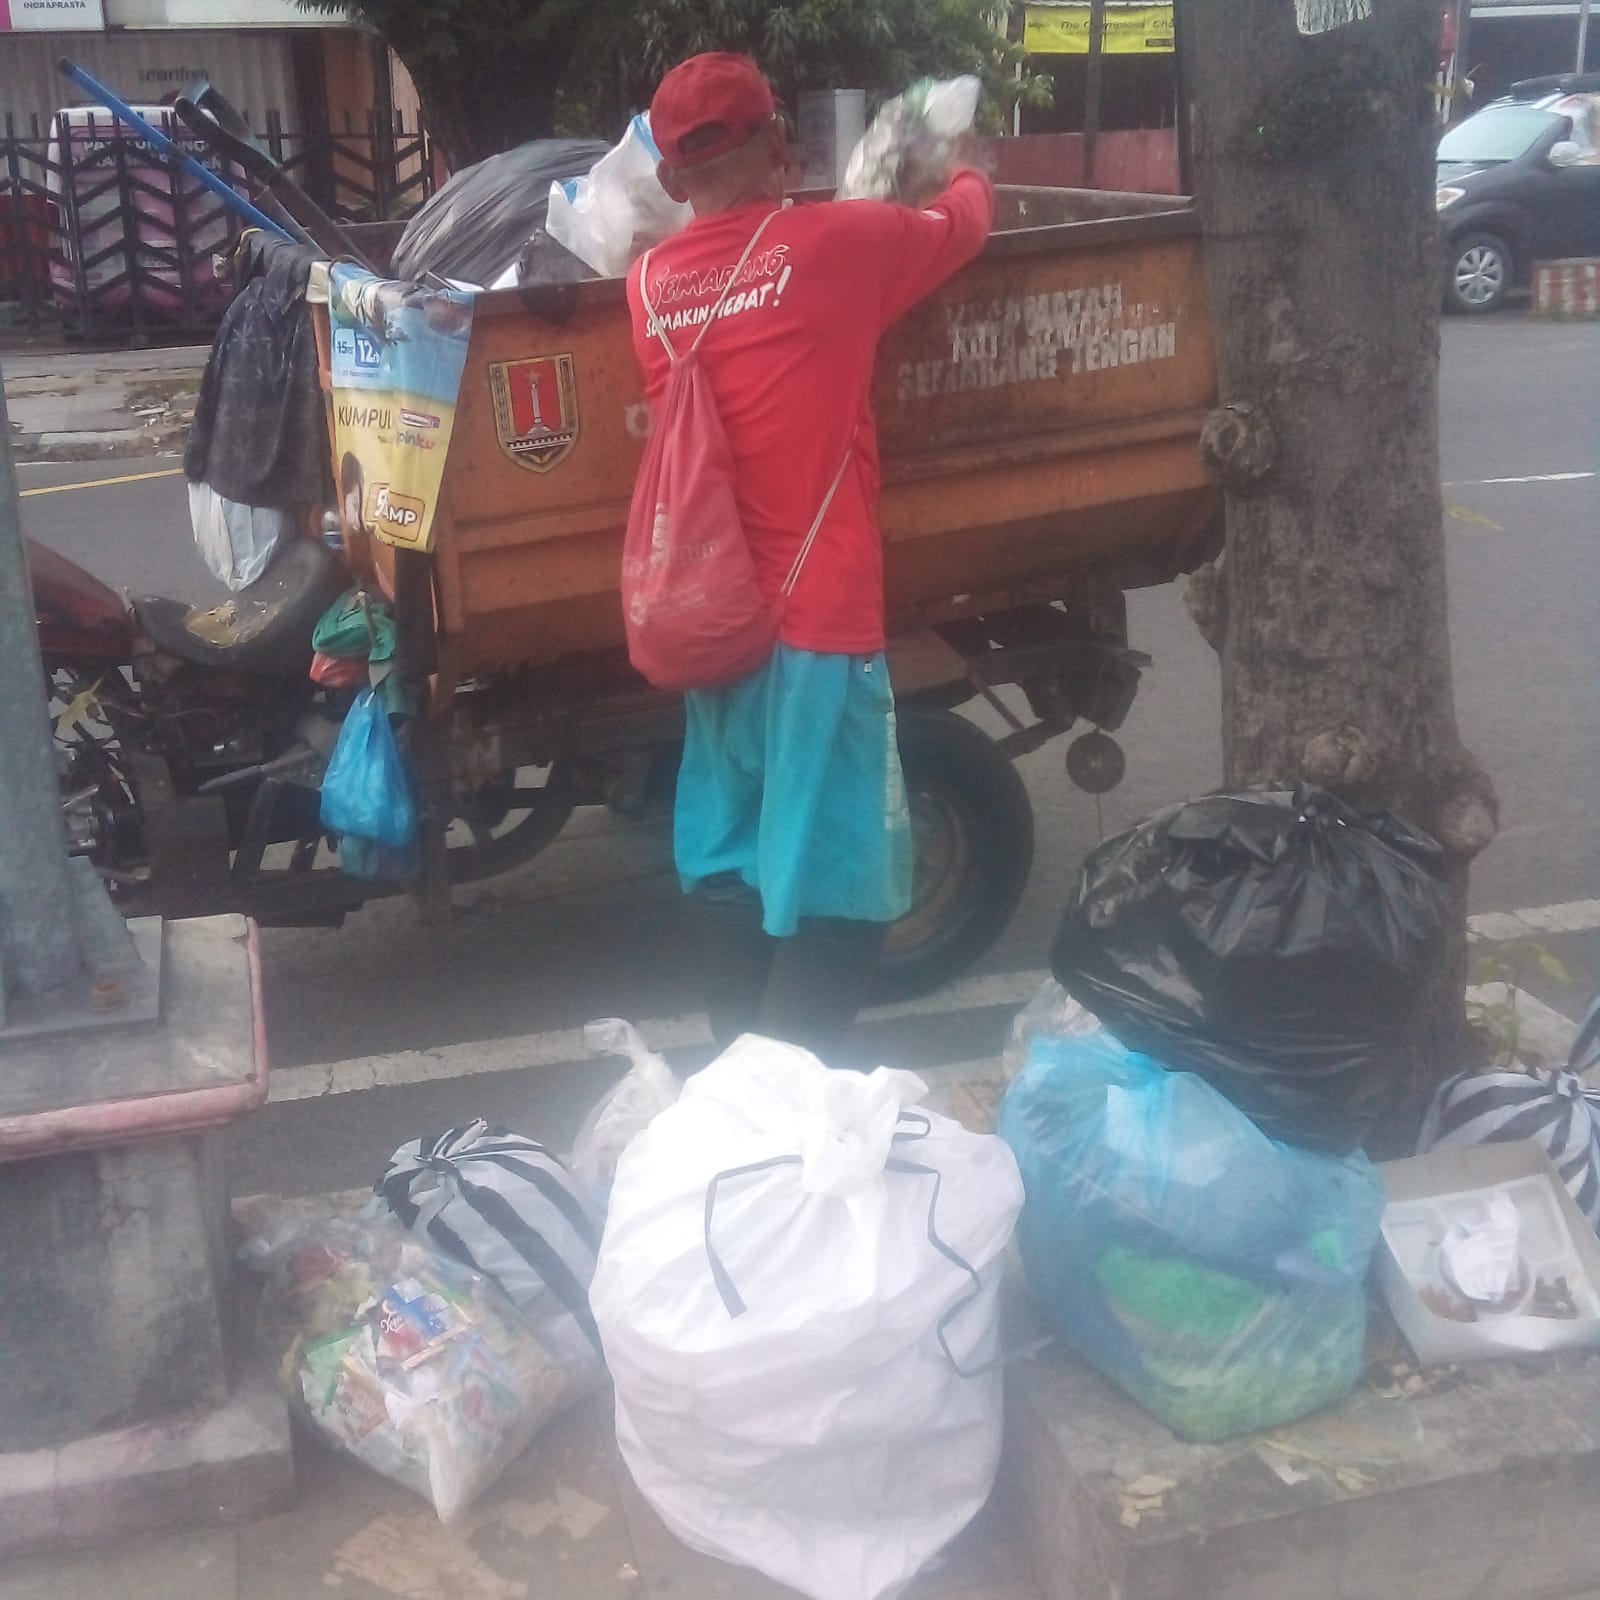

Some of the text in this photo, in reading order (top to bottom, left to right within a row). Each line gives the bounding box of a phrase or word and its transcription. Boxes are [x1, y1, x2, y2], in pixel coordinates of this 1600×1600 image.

[23, 1, 86, 9] INDRAPRASTA
[1061, 21, 1079, 29] The
[139, 66, 209, 82] smartfren
[650, 244, 790, 310] SEMARANG
